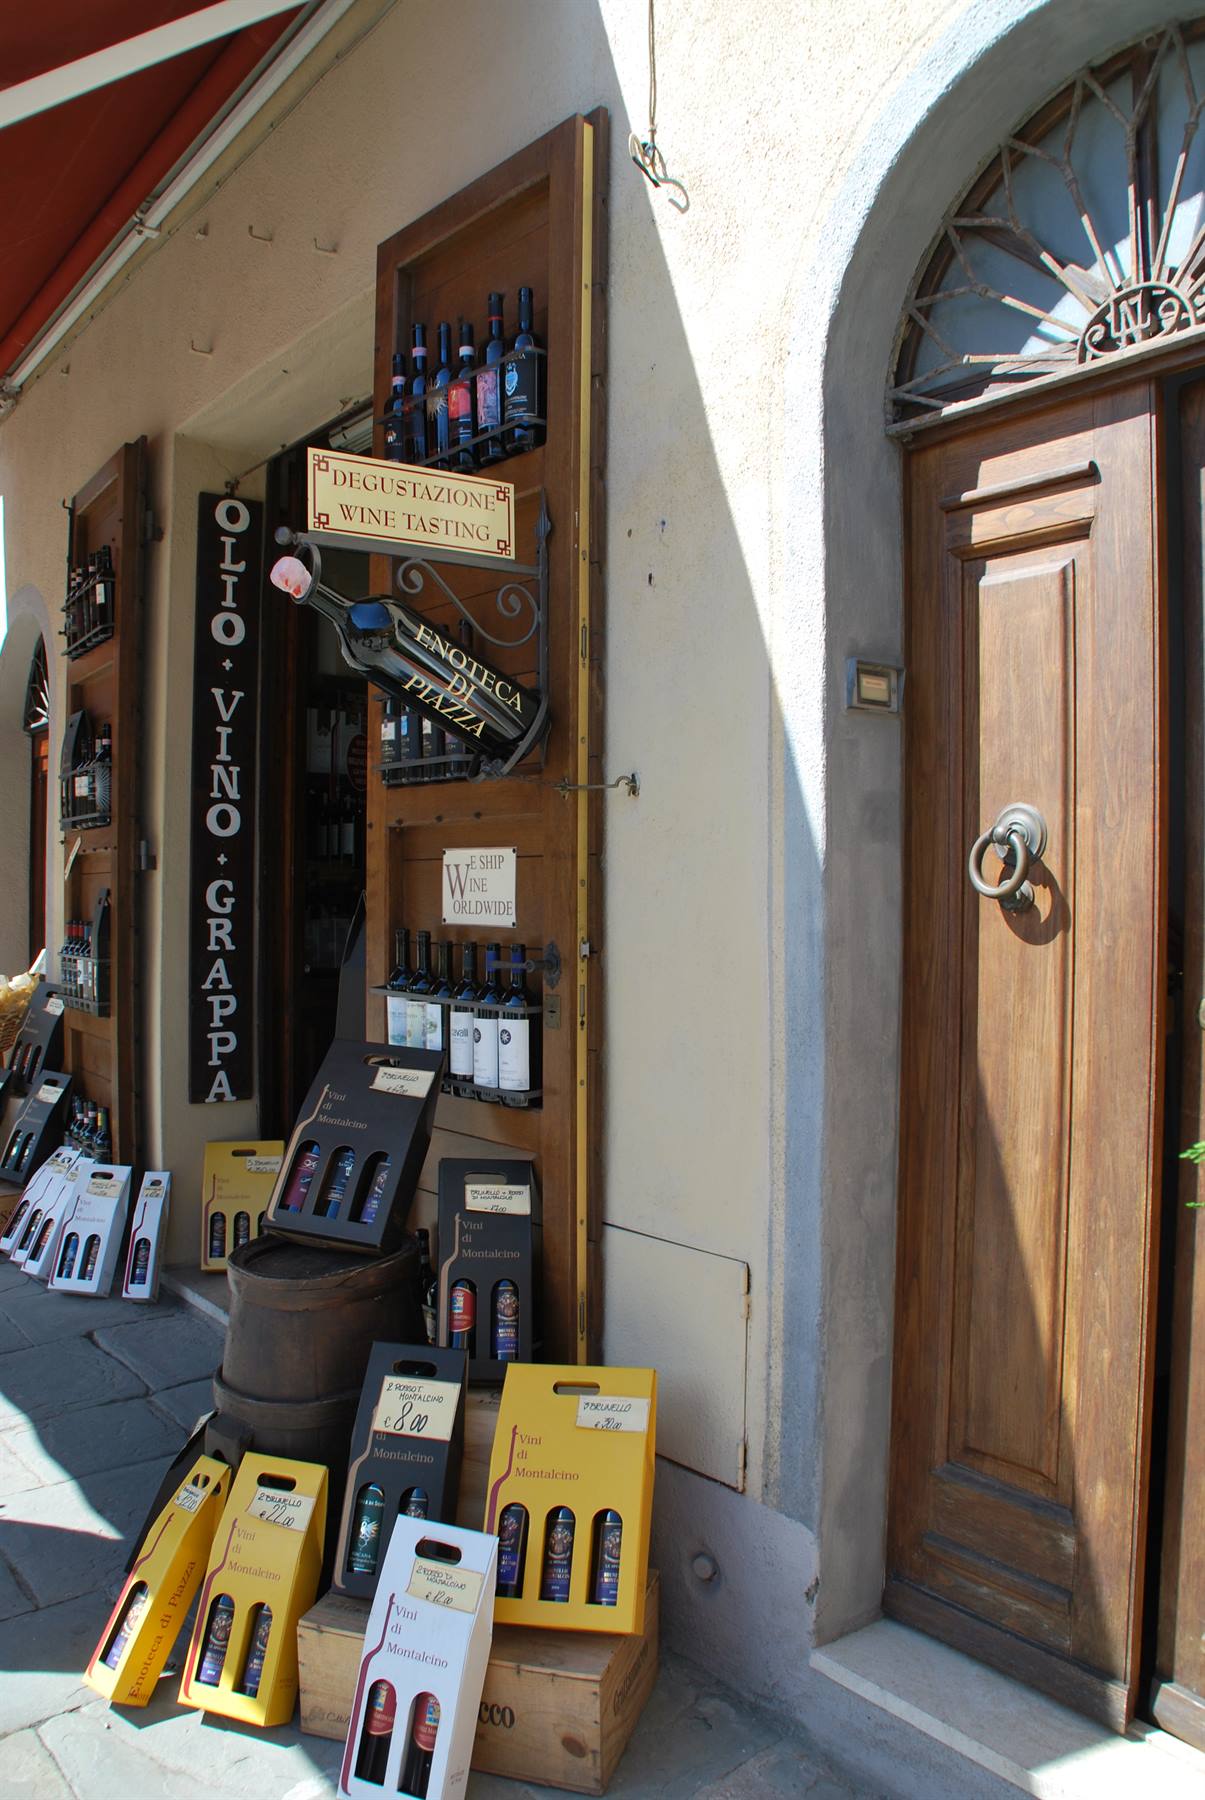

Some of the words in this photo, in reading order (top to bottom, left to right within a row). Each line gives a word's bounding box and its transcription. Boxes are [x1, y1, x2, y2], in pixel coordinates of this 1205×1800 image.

[333, 469, 496, 512] DEGUSTAZIONE
[338, 503, 396, 528] WINE
[402, 512, 491, 542] TASTING
[211, 499, 250, 646] OLIO
[414, 624, 522, 713] ENOTECA
[445, 671, 478, 705] DI
[402, 674, 486, 738] PIAZZA
[206, 687, 245, 838] VINO
[479, 854, 504, 870] SHIP
[201, 879, 238, 1103] GRAPPA
[328, 1090, 346, 1101] Vini
[318, 1115, 368, 1129] Montalcino
[463, 1221, 483, 1230] Vini
[462, 1233, 472, 1243] di
[462, 1249, 520, 1258] Montalcino
[399, 1392, 444, 1404] MONTALCINO
[519, 1434, 542, 1445] Vini
[373, 1447, 434, 1463] Montalcino
[516, 1450, 528, 1460] di
[515, 1468, 580, 1481] Montalcino
[238, 1528, 256, 1541] Vini
[232, 1543, 242, 1554] di
[227, 1561, 280, 1582] Montalcino
[396, 1605, 418, 1621] Vini
[128, 1633, 164, 1699] Enoteca
[160, 1613, 172, 1629] di
[169, 1560, 197, 1608] Piazza
[391, 1623, 402, 1635] di
[387, 1641, 448, 1669] Montalcino
